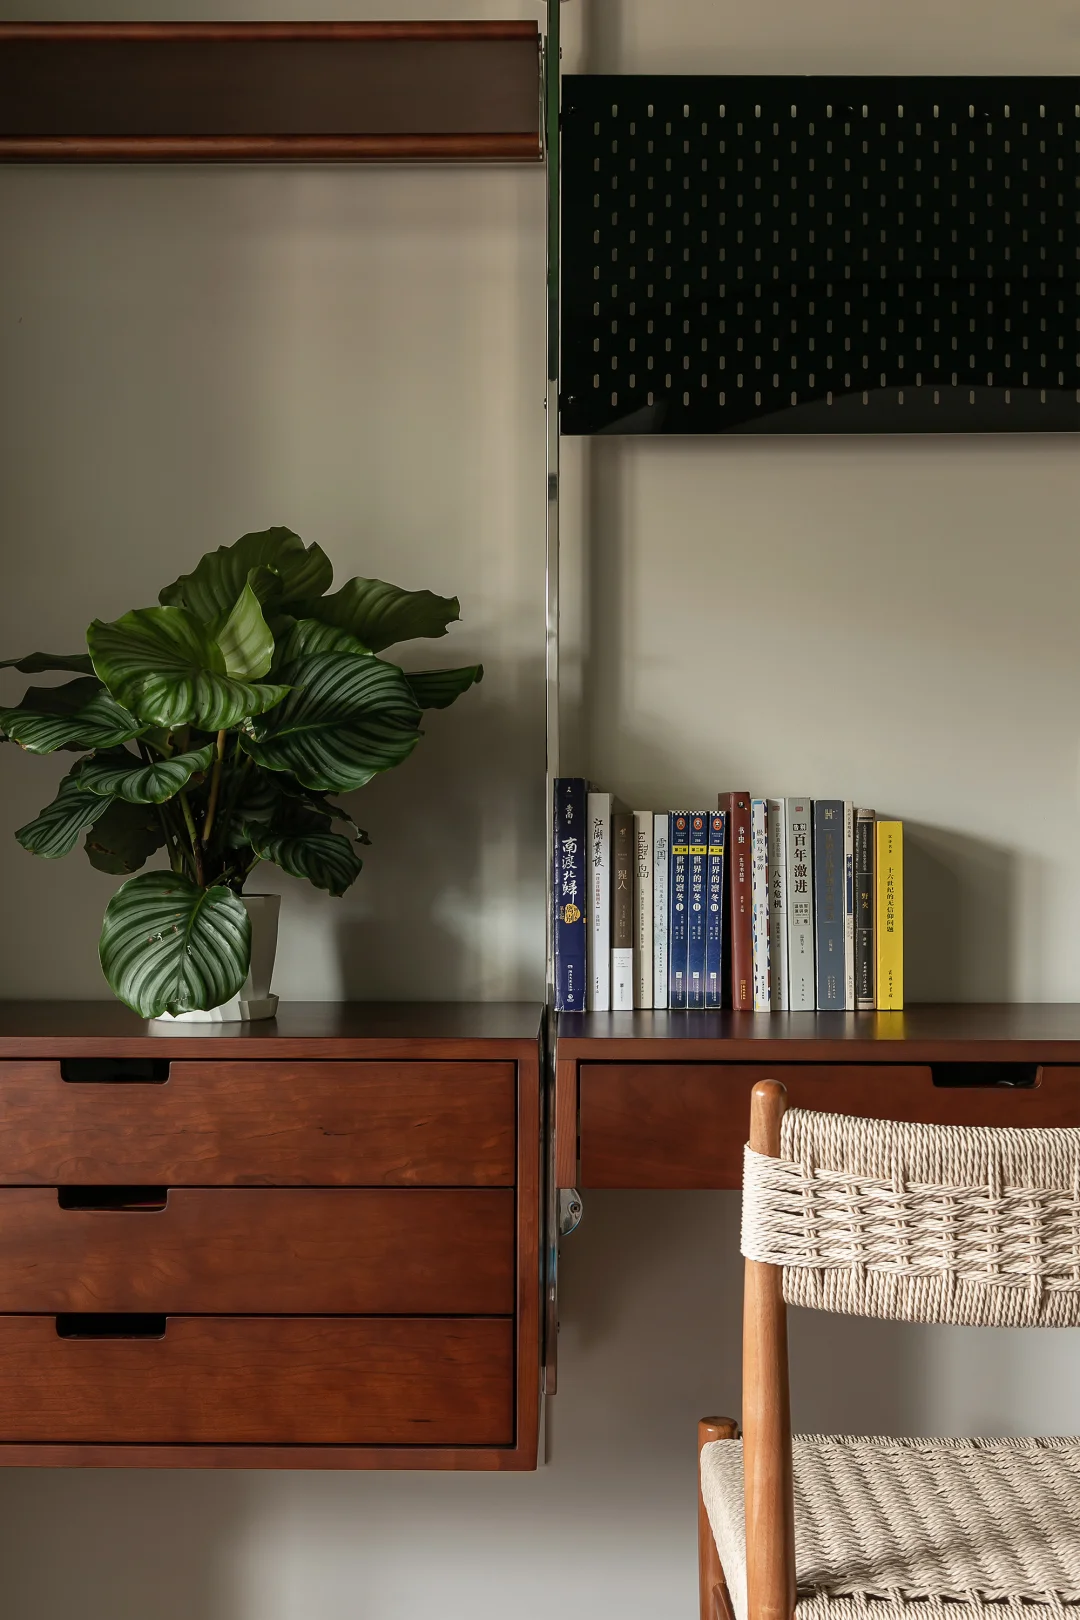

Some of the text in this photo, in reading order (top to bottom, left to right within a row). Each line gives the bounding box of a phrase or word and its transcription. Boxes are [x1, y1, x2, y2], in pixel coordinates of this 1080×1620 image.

[657, 838, 666, 860] 雪国
[738, 827, 744, 844] 书虫
[637, 864, 649, 878] 岛
[676, 856, 684, 901] 世界的凛冬
[693, 856, 701, 901] 世界的凛冬
[711, 857, 720, 902] 世界的凛冬
[794, 833, 808, 893] 百年激进
[773, 870, 782, 908] 八次危机
[862, 893, 868, 908] 野火
